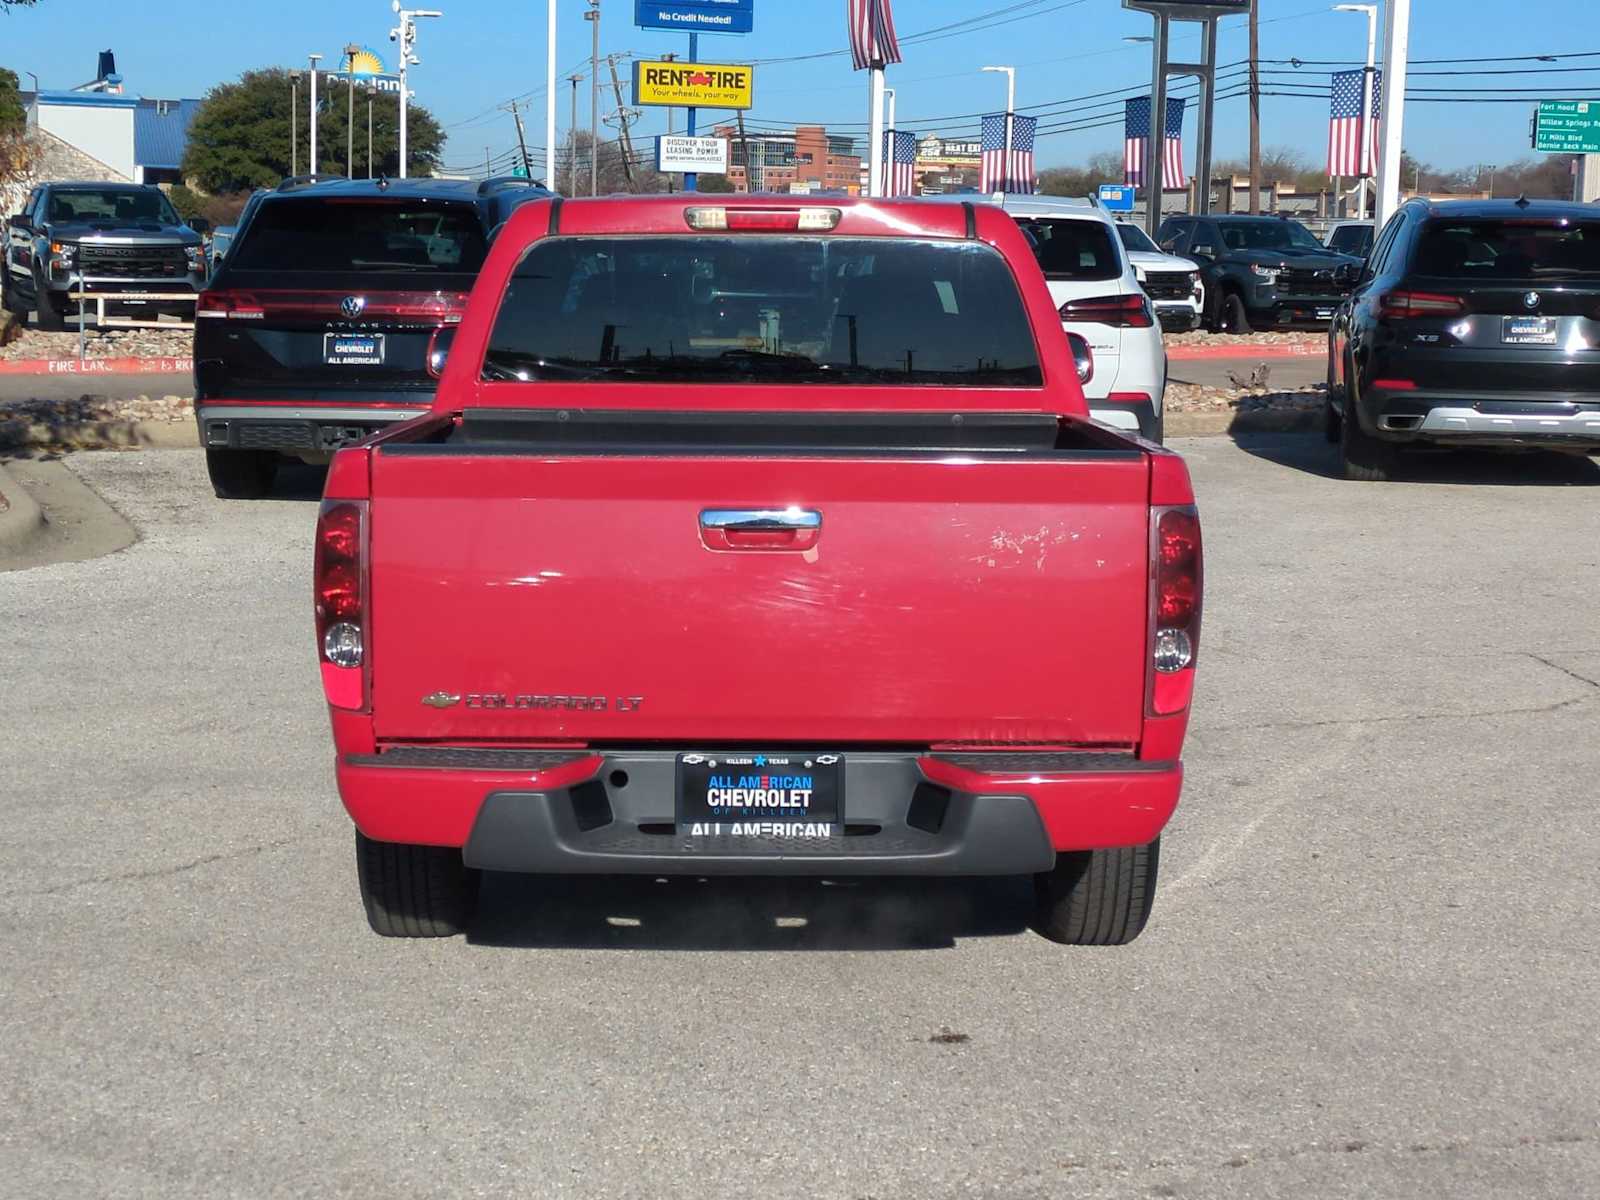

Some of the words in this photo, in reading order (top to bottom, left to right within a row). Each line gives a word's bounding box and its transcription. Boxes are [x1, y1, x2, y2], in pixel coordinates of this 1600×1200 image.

[659, 12, 671, 20] No
[672, 13, 697, 22] Credit
[698, 14, 732, 24] Needed!
[652, 87, 670, 96] Your
[703, 91, 721, 99] your
[723, 92, 739, 100] way
[666, 138, 697, 147] DISCOVER
[666, 146, 693, 154] LEASING
[335, 345, 375, 353] CHEVROLET
[48, 360, 77, 373] FIRE
[466, 694, 608, 712] COLORADO
[616, 697, 643, 712] LT
[709, 776, 735, 788] ALL
[738, 775, 812, 789] AMERICAN
[707, 789, 812, 808] CHEVROLET
[743, 808, 807, 816] KILLEEN
